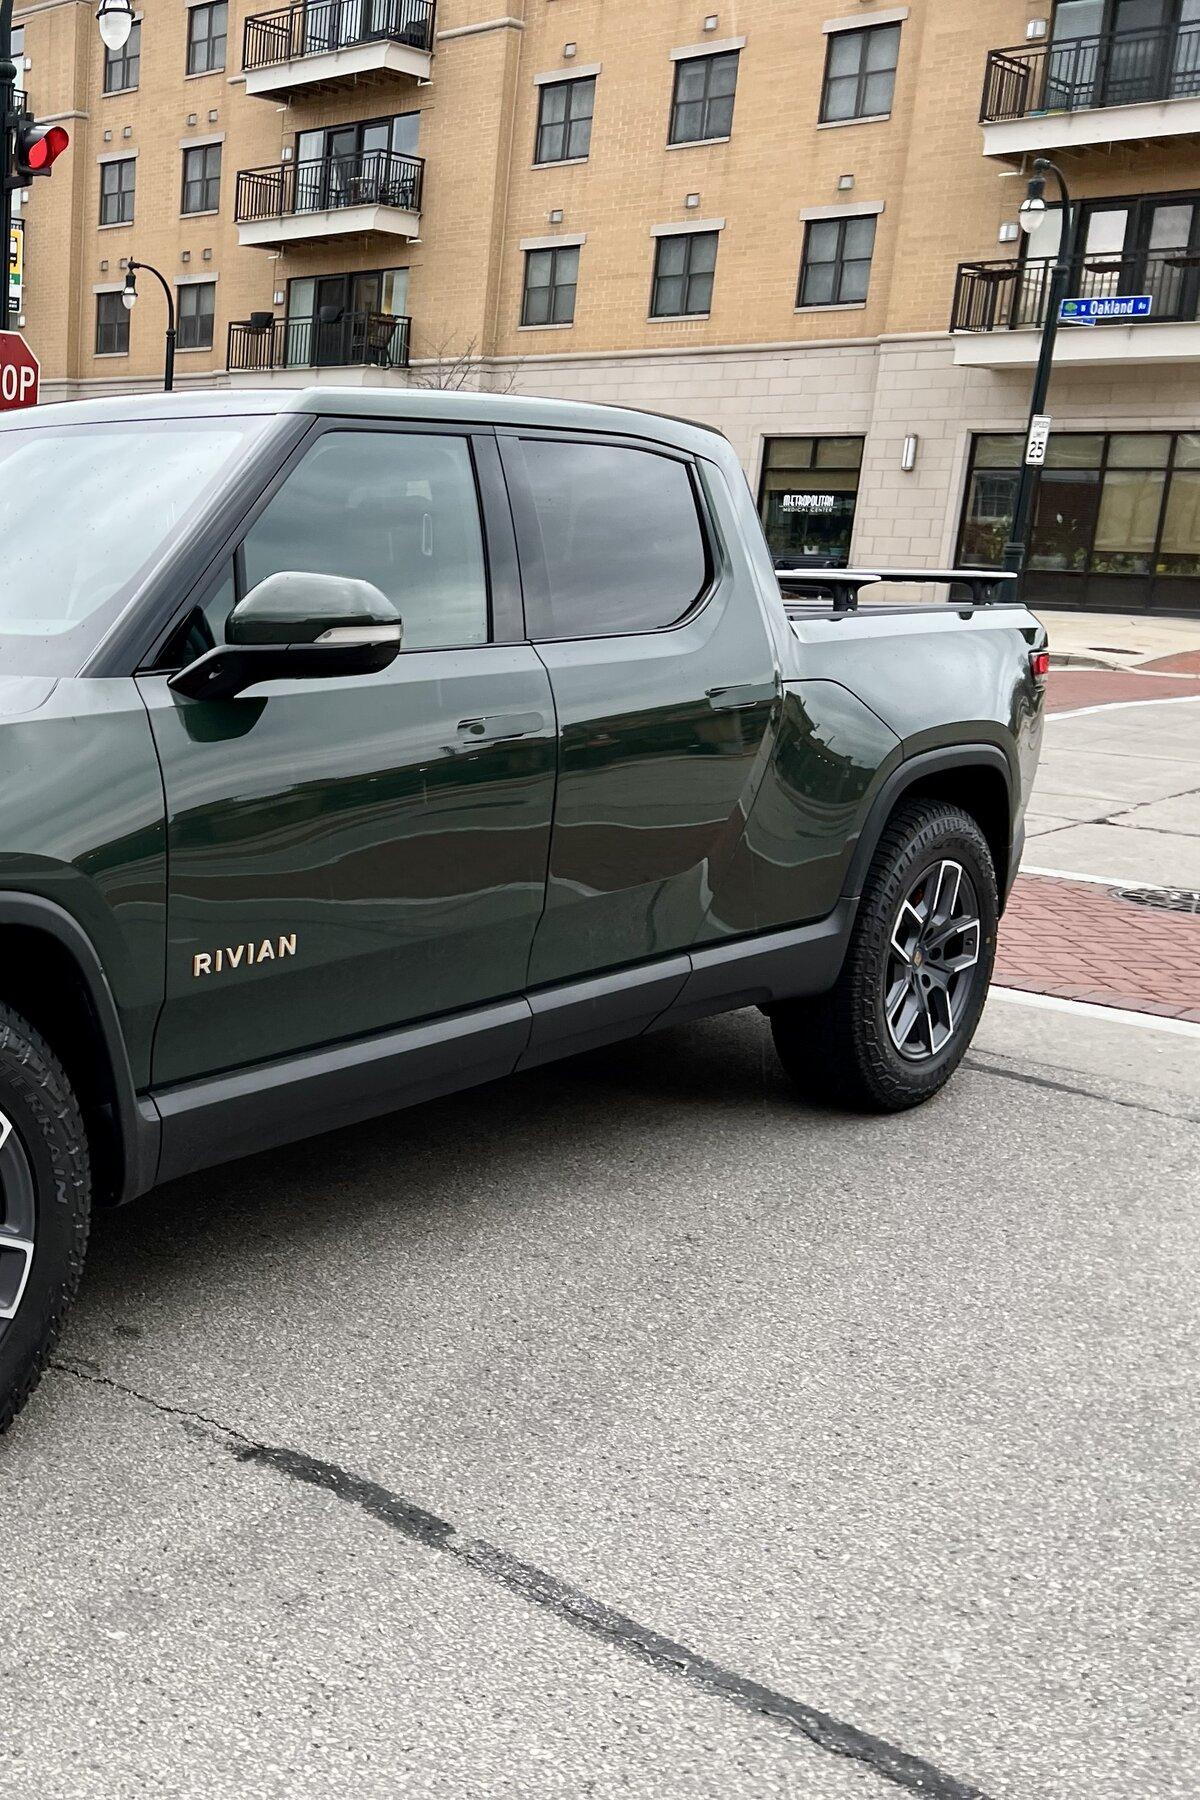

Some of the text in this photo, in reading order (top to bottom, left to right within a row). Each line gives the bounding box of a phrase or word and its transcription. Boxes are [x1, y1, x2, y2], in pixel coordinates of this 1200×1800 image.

[1090, 299, 1134, 315] Oakland
[1029, 441, 1045, 458] 25
[782, 494, 835, 507] METROPOLITAN
[192, 933, 297, 977] RIVIAN
